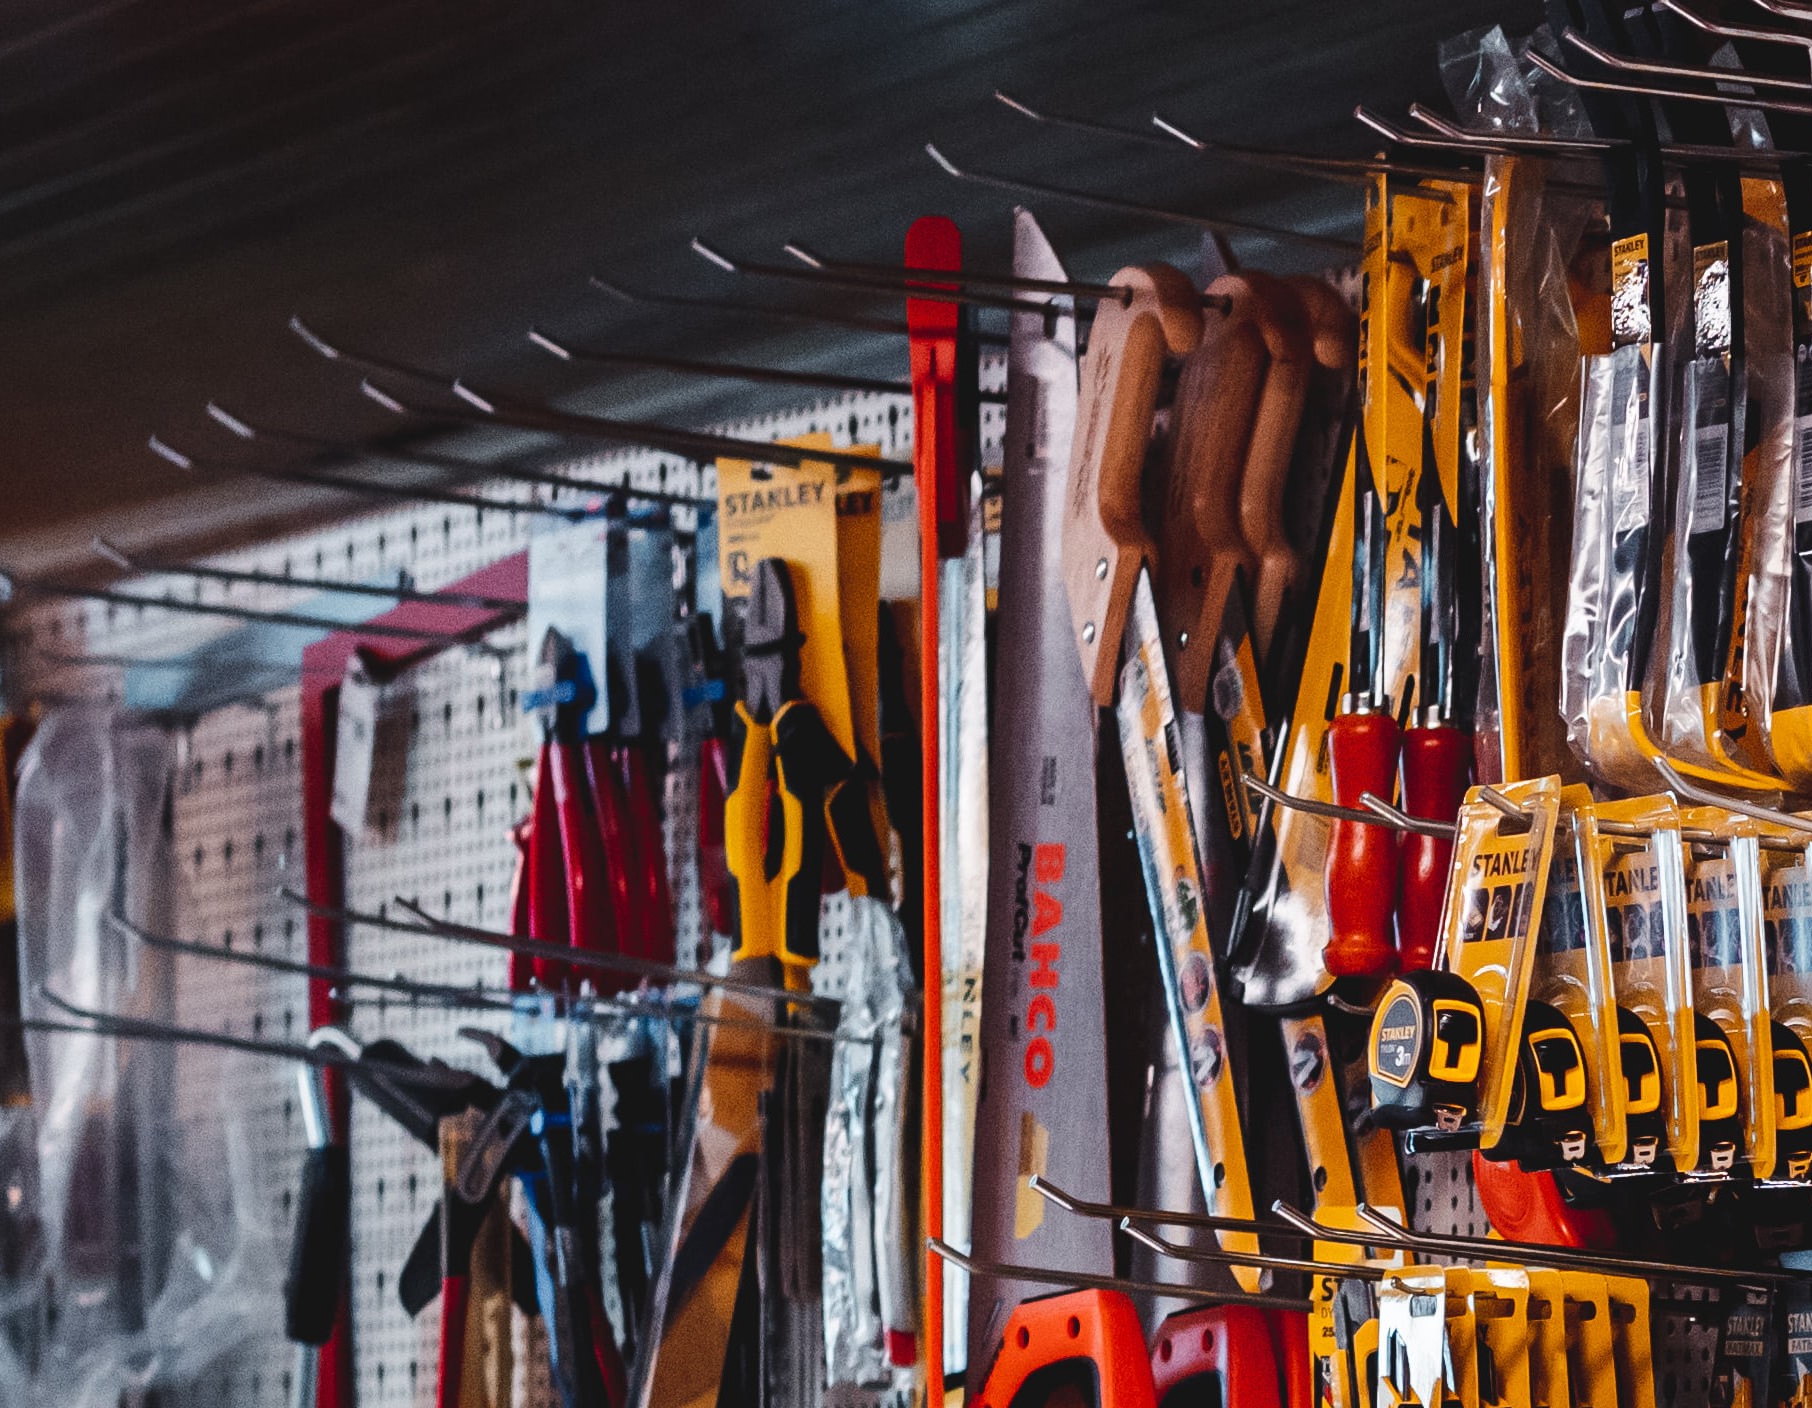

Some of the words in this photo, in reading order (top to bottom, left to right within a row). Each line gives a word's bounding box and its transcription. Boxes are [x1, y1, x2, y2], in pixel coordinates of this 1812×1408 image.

[725, 480, 825, 517] STANLEY
[1023, 843, 1066, 1088] BAHCO
[1381, 1025, 1417, 1041] STANLEY
